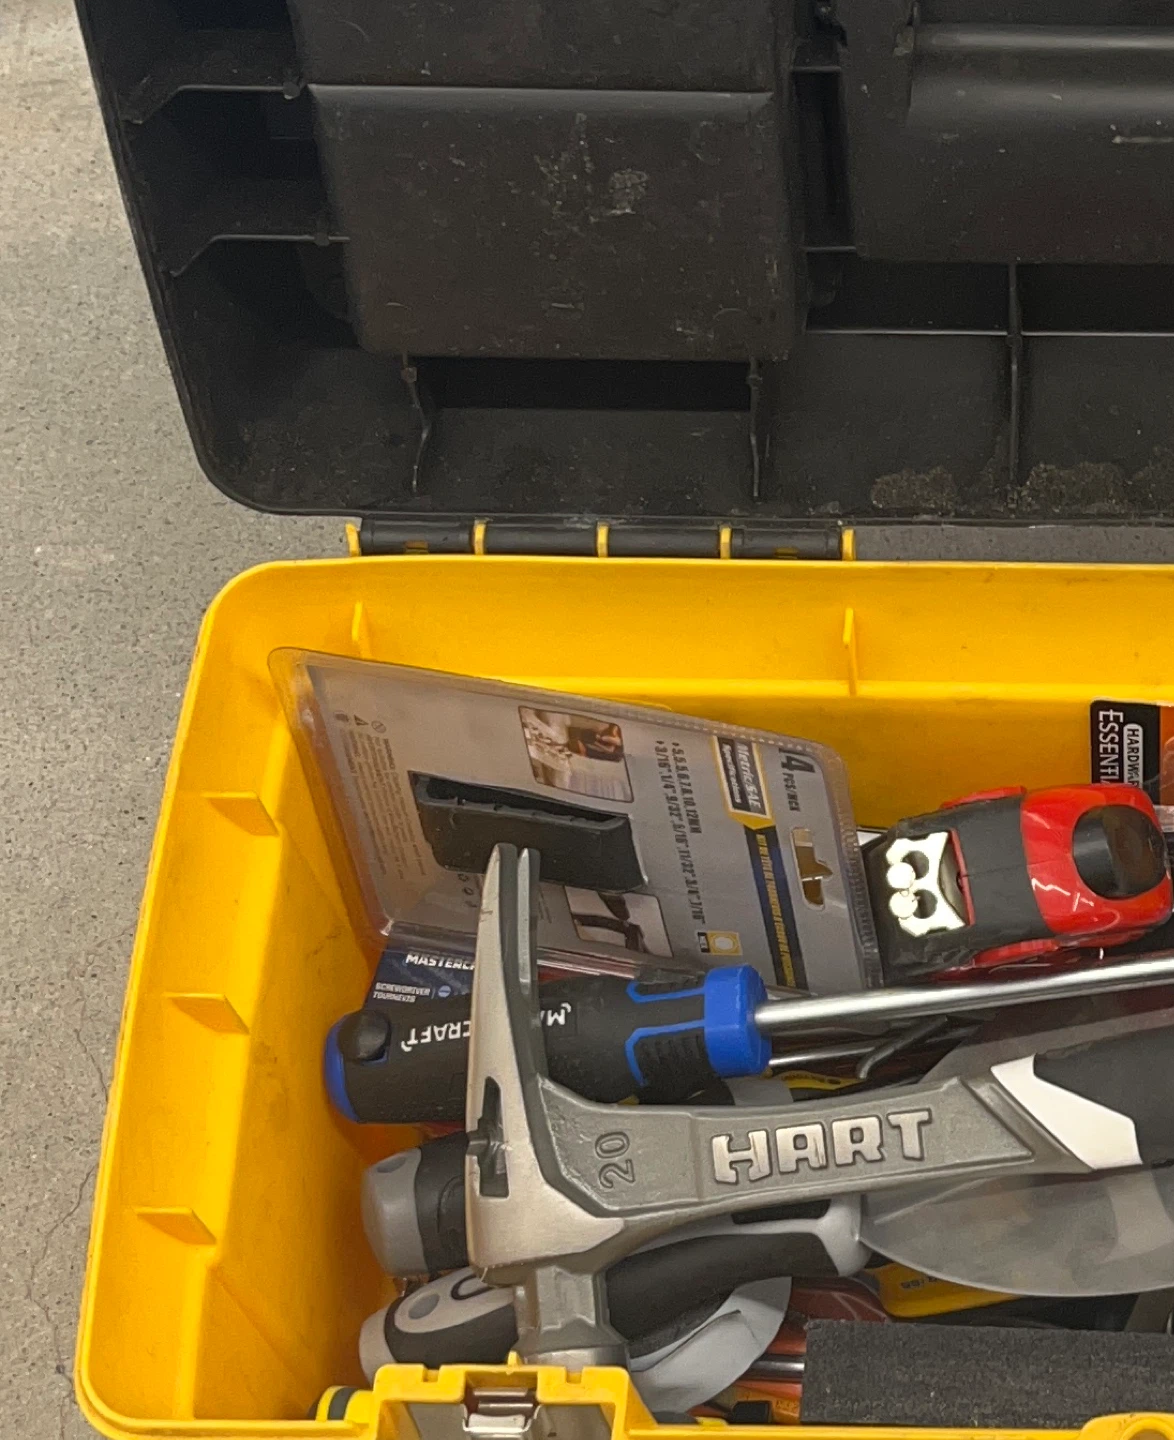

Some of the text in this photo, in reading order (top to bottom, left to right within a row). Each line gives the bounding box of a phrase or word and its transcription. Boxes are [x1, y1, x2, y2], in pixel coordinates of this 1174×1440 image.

[1098, 709, 1123, 785] ESSENTI
[594, 1131, 636, 1190] 20
[712, 1108, 932, 1185] HART
